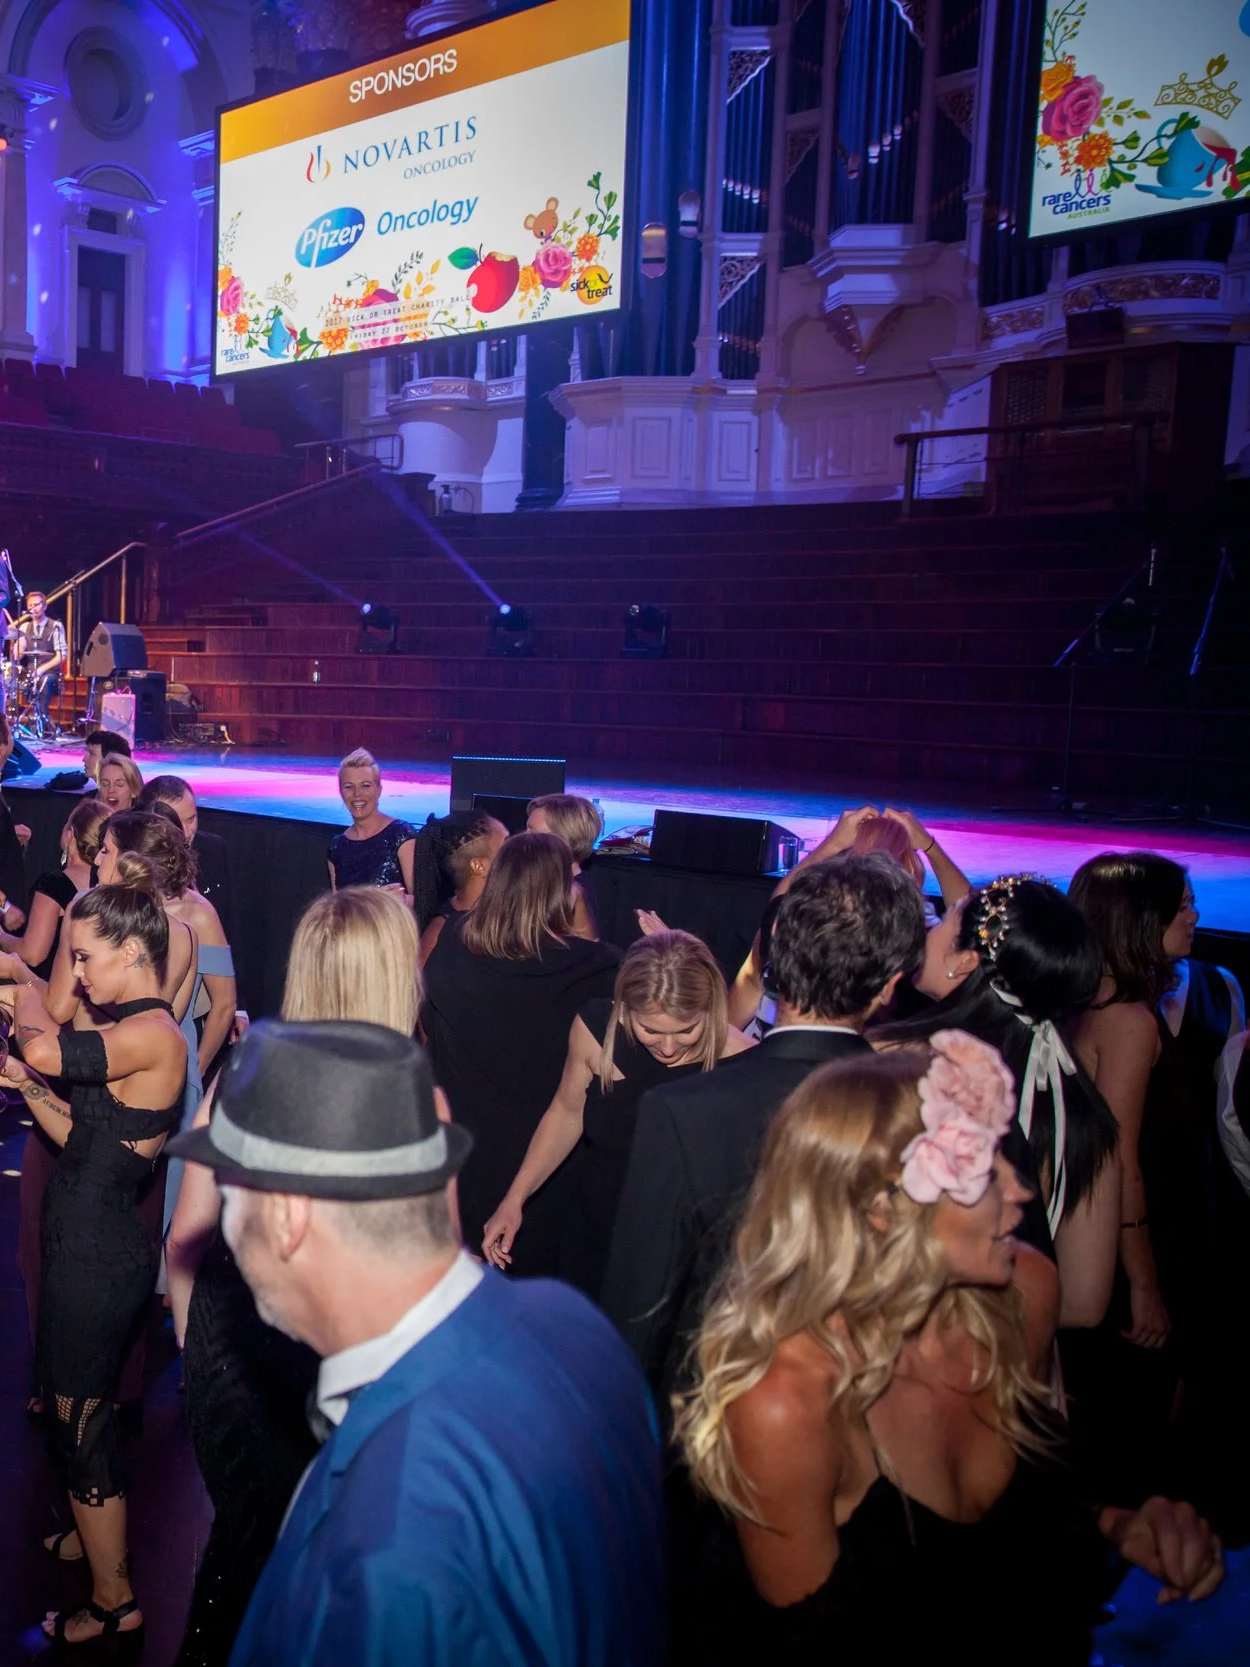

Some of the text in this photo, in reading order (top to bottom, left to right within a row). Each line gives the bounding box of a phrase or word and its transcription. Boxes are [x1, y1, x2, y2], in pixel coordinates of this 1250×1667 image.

[349, 49, 458, 103] SPONSORS
[343, 116, 477, 174] NOVARTIS
[403, 150, 476, 180] ONCOLOGY
[1042, 192, 1072, 206] rare
[1053, 194, 1111, 215] cancers
[1067, 206, 1110, 219] AUSTRALIA
[301, 196, 479, 268] Pfizer Oncology
[570, 278, 590, 292] sick
[587, 285, 612, 299] treat
[325, 316, 343, 327] 2017
[370, 311, 378, 319] OR
[383, 305, 406, 316] TREAT
[411, 300, 445, 311] CHARITY
[382, 327, 390, 335] 27
[395, 322, 428, 332] OCTOBER
